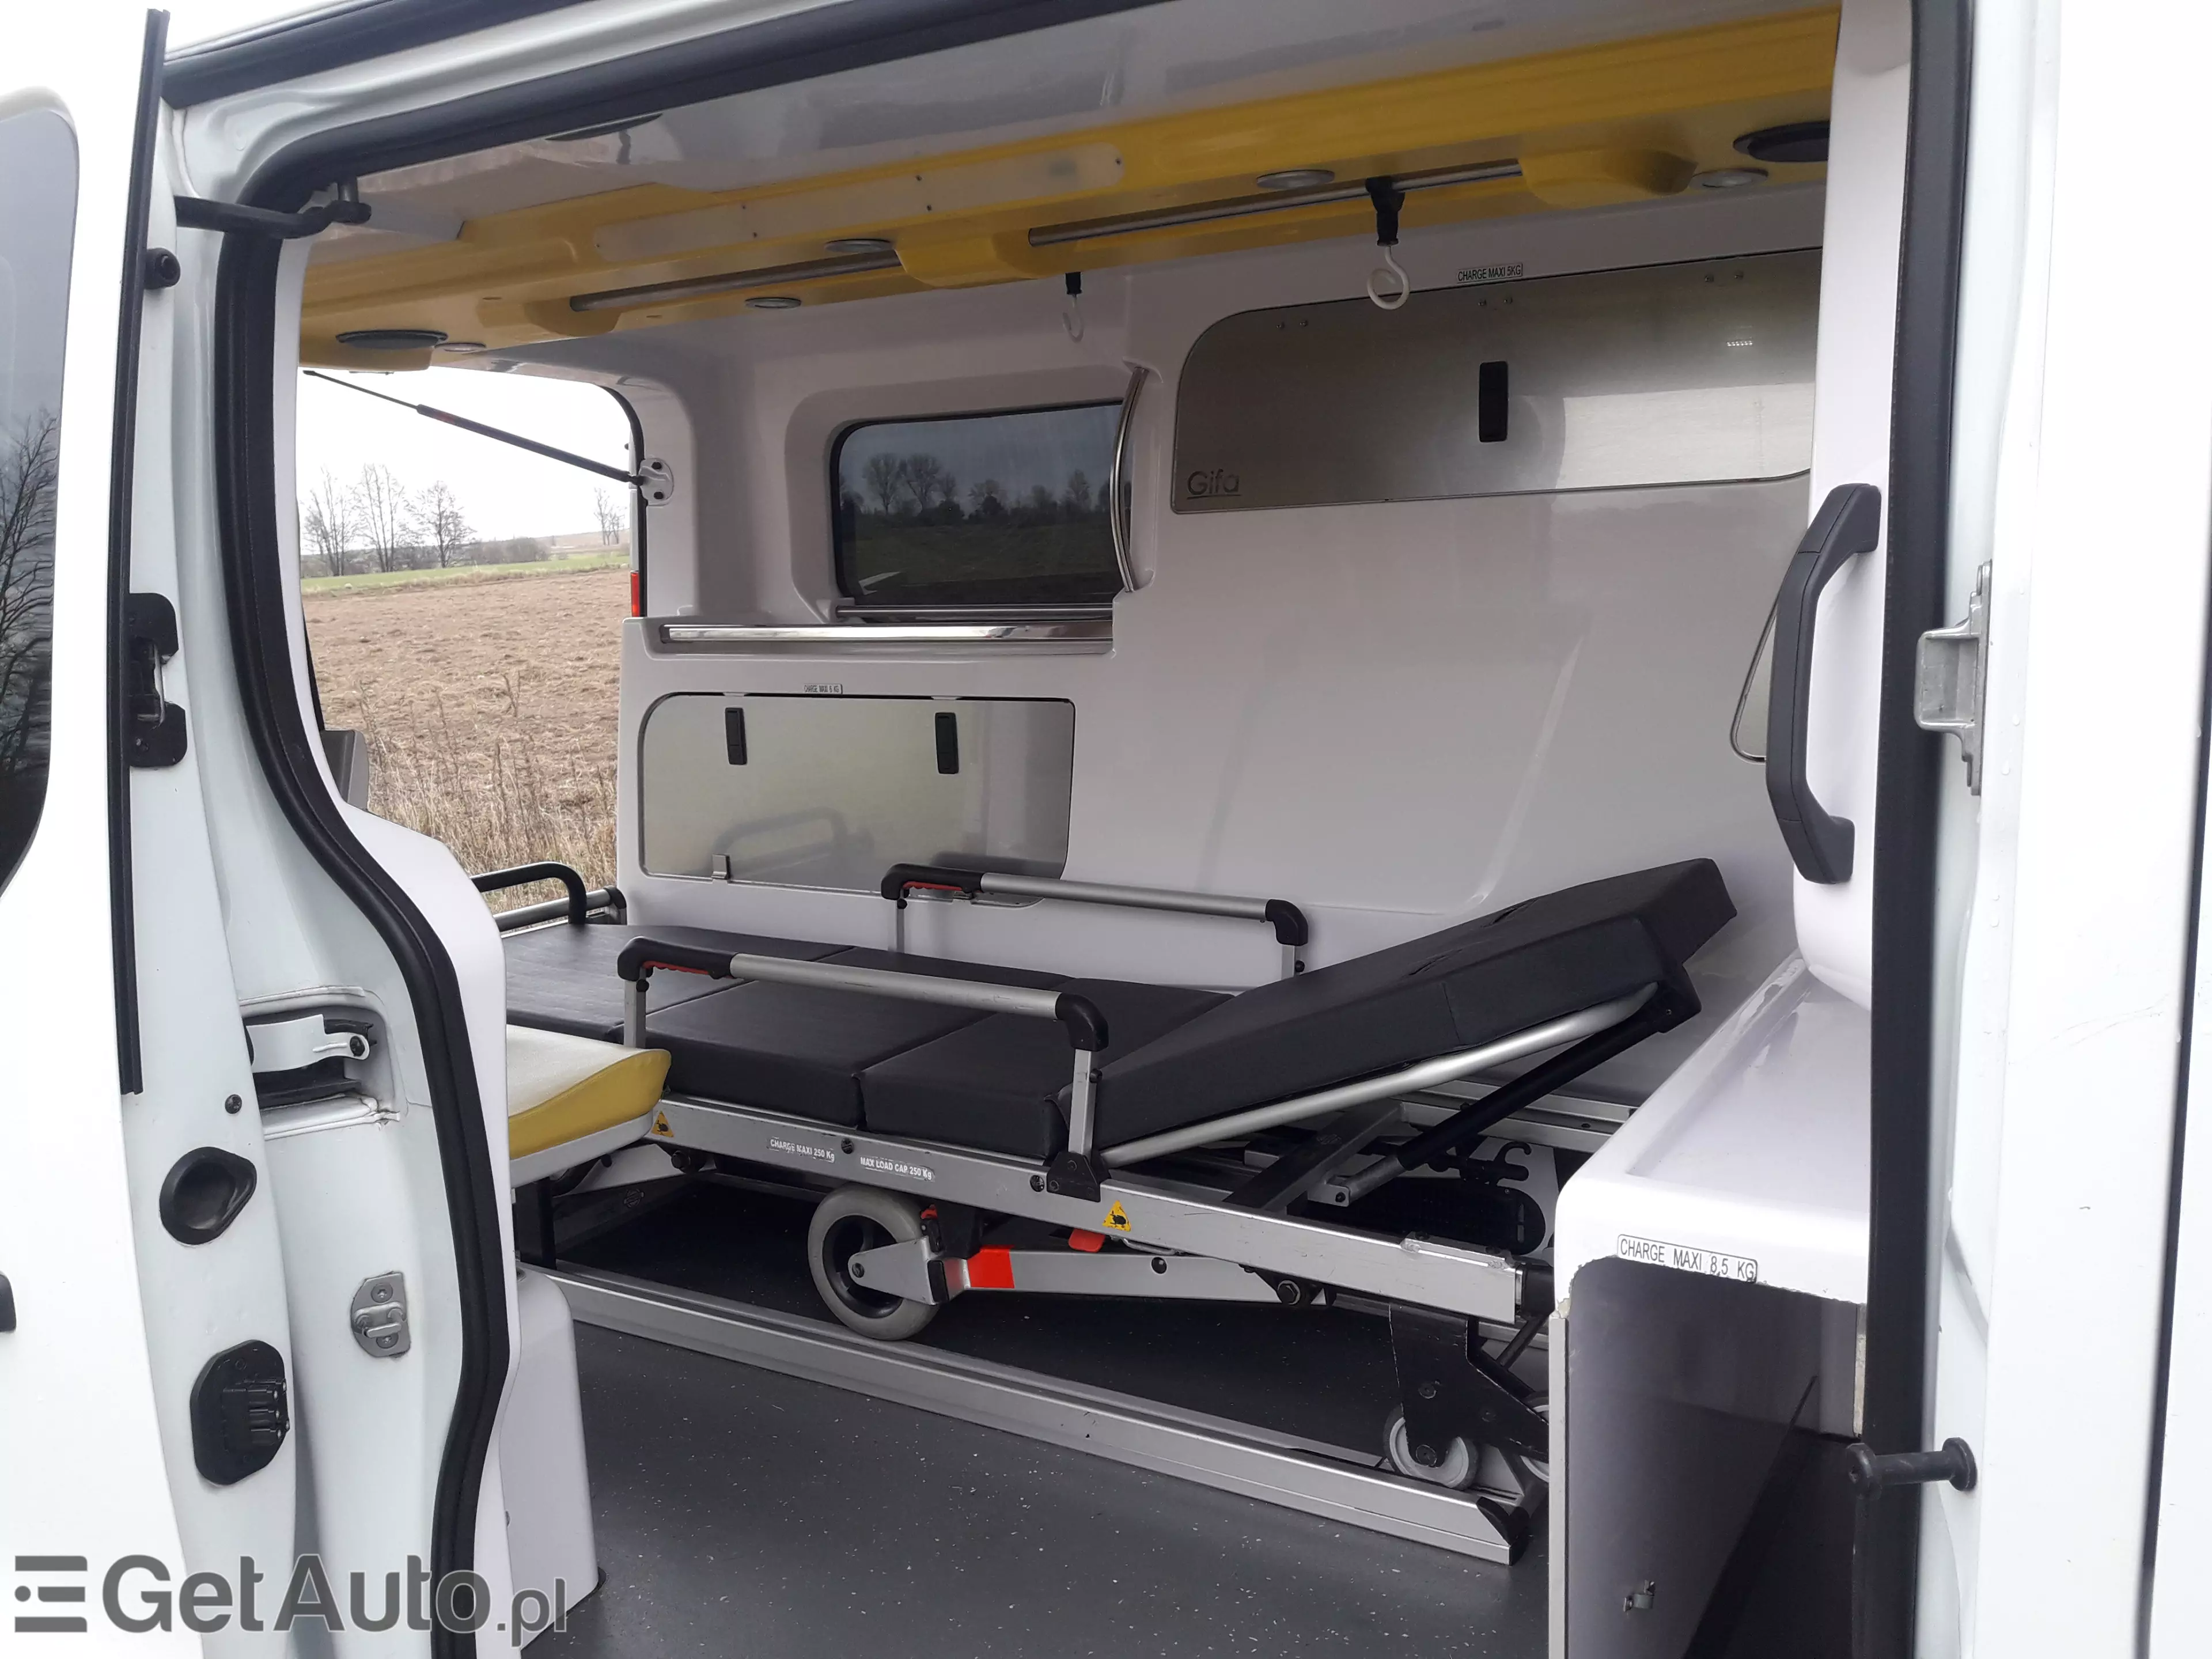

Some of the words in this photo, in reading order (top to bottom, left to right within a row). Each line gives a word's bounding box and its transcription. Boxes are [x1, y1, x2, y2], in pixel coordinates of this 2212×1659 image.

[1458, 268, 1487, 281] CHARGE
[1488, 267, 1505, 278] MAXI
[1507, 265, 1521, 276] 5KG
[1187, 468, 1239, 495] Gifa
[770, 1139, 795, 1151] CHARGE
[796, 1145, 812, 1155] MAXI
[814, 1149, 825, 1157] 250
[826, 1151, 835, 1162] Kg
[861, 1157, 874, 1166] MAX
[876, 1160, 893, 1171] LOAD
[895, 1164, 908, 1173] CAP
[910, 1166, 921, 1176] 250
[922, 1168, 932, 1180] Kg
[1620, 1238, 1665, 1263] CHARGE
[1673, 1248, 1702, 1271] MAXI
[1710, 1256, 1728, 1277] 8,5
[1737, 1261, 1755, 1281] KG
